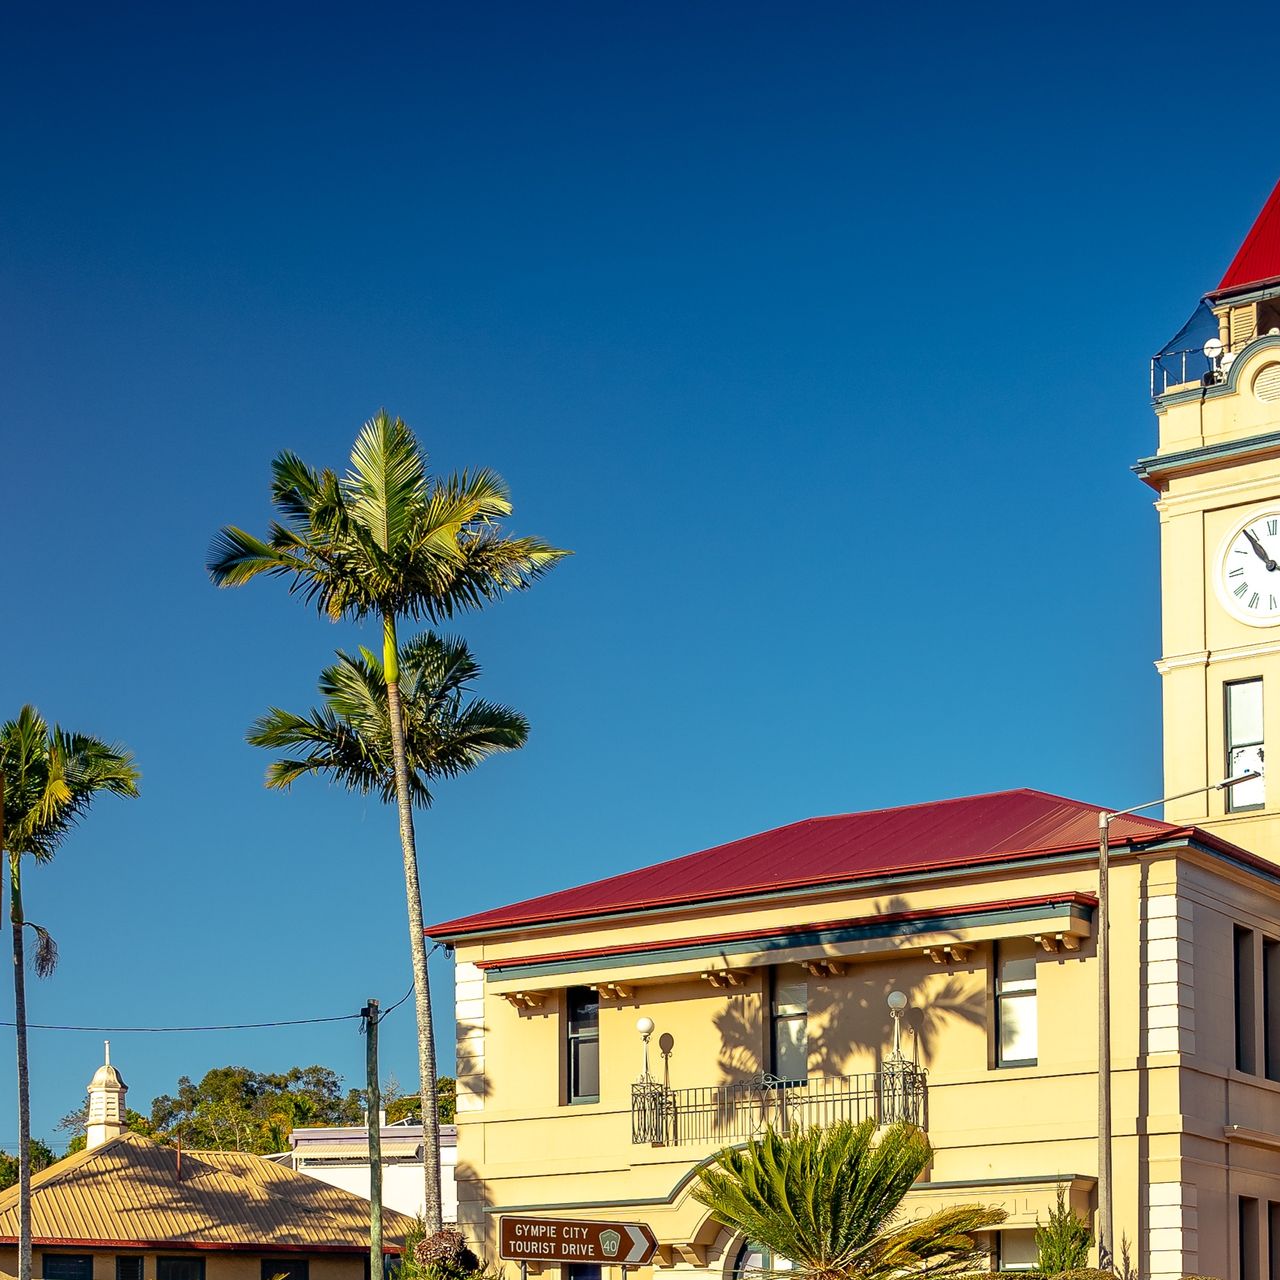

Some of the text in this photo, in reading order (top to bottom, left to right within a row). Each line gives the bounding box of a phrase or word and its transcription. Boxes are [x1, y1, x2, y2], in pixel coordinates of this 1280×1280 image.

[515, 1224, 588, 1239] GYMPIE CITY
[509, 1240, 617, 1256] TOURIST DRIVE 40
